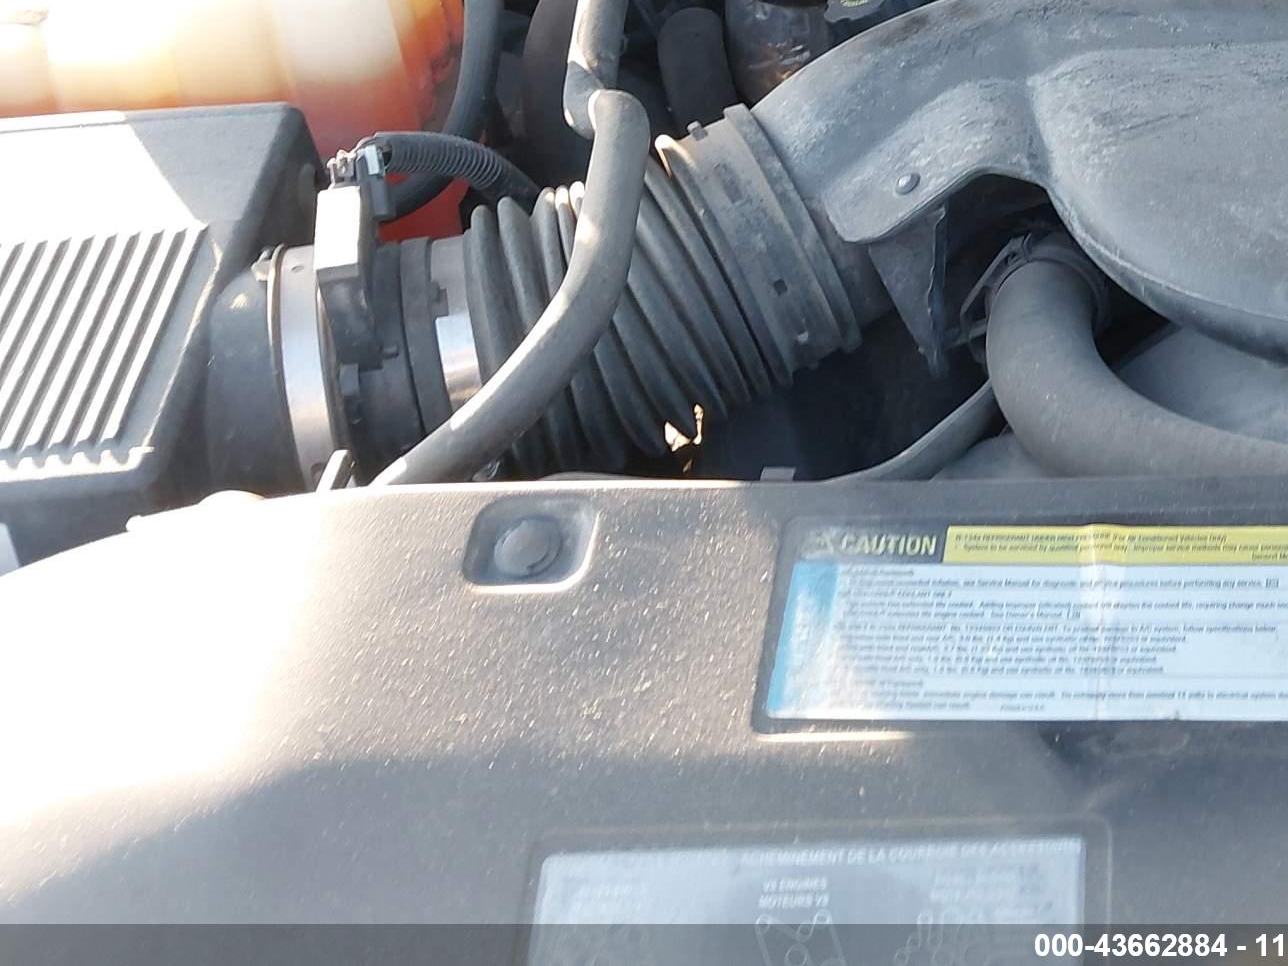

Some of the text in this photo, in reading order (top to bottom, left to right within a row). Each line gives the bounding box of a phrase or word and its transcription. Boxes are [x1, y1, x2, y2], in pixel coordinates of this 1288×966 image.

[840, 533, 937, 556] CAUTION
[847, 848, 866, 865] DE
[868, 847, 888, 864] LA
